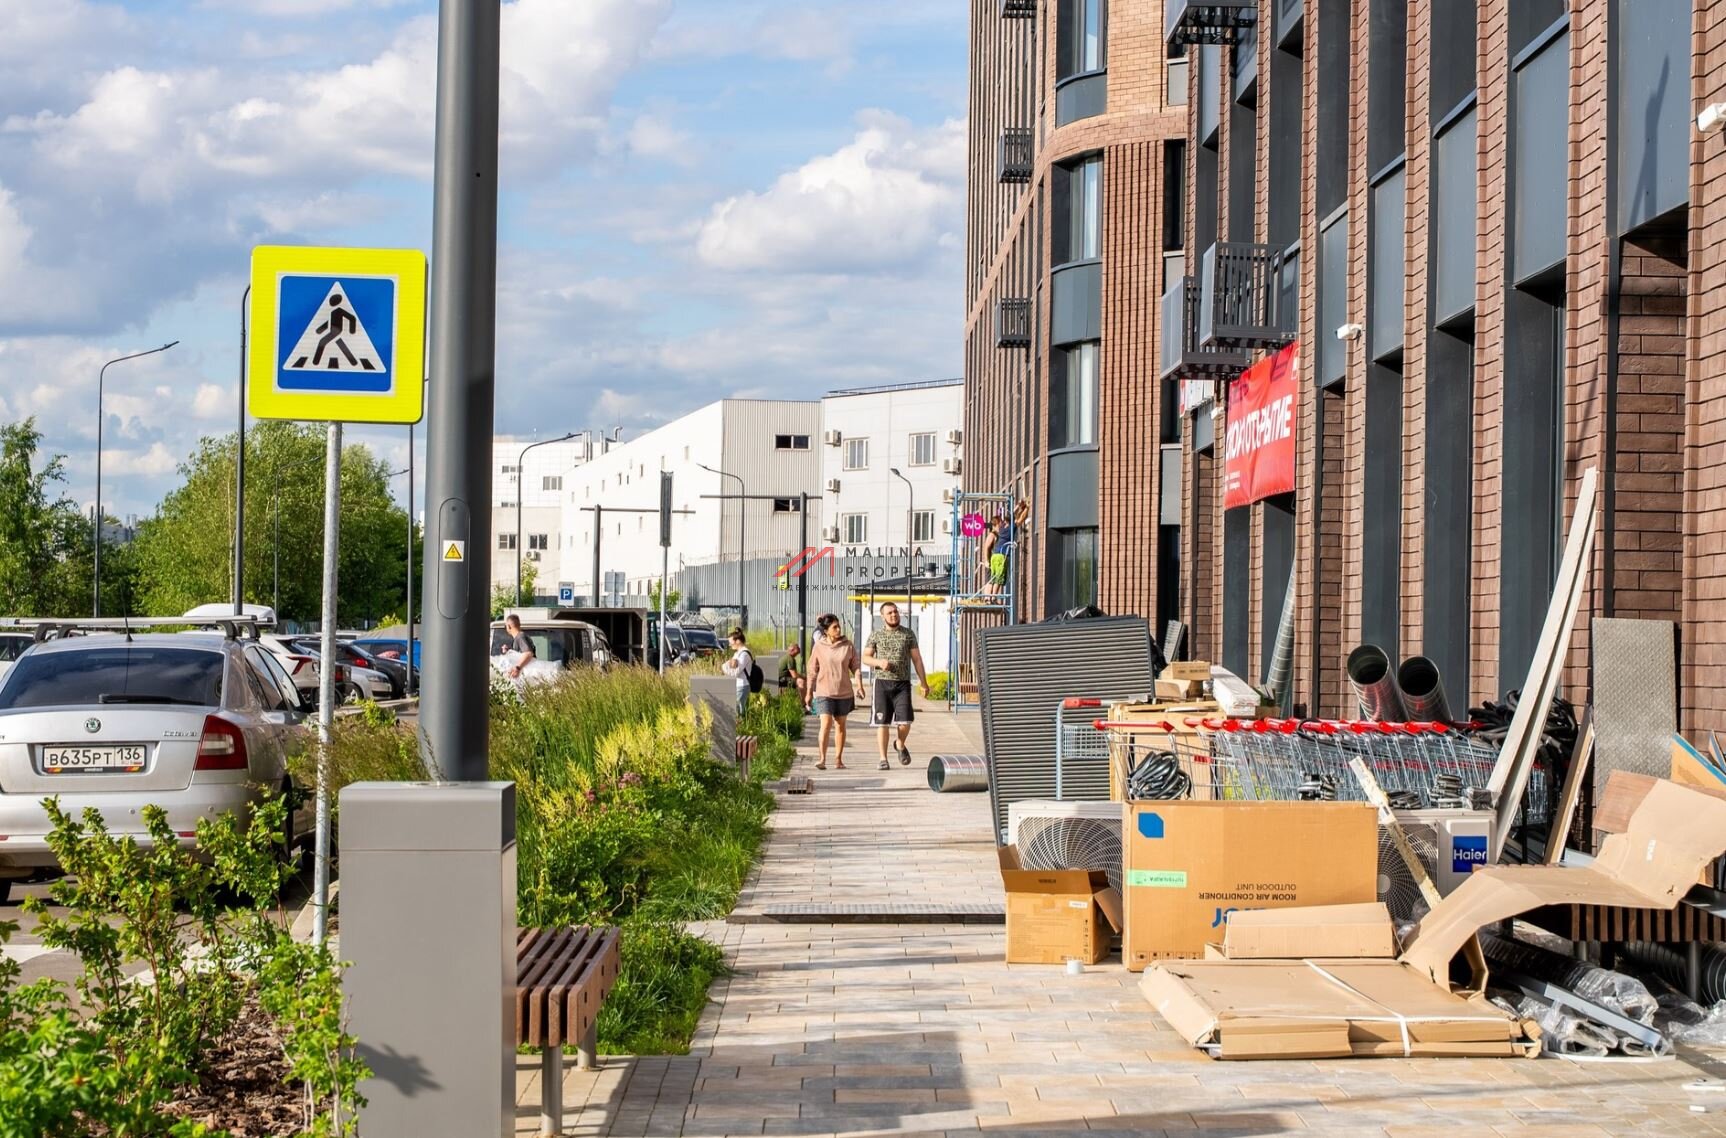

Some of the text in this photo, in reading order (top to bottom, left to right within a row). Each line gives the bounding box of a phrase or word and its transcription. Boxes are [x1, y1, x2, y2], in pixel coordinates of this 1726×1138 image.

[964, 521, 982, 530] wb
[563, 589, 571, 599] P
[116, 747, 141, 760] 136
[1453, 848, 1486, 860] Haier
[1235, 883, 1297, 891] OUTDOOR UNIT
[1198, 892, 1297, 901] ROOM AIR CONDITIONER
